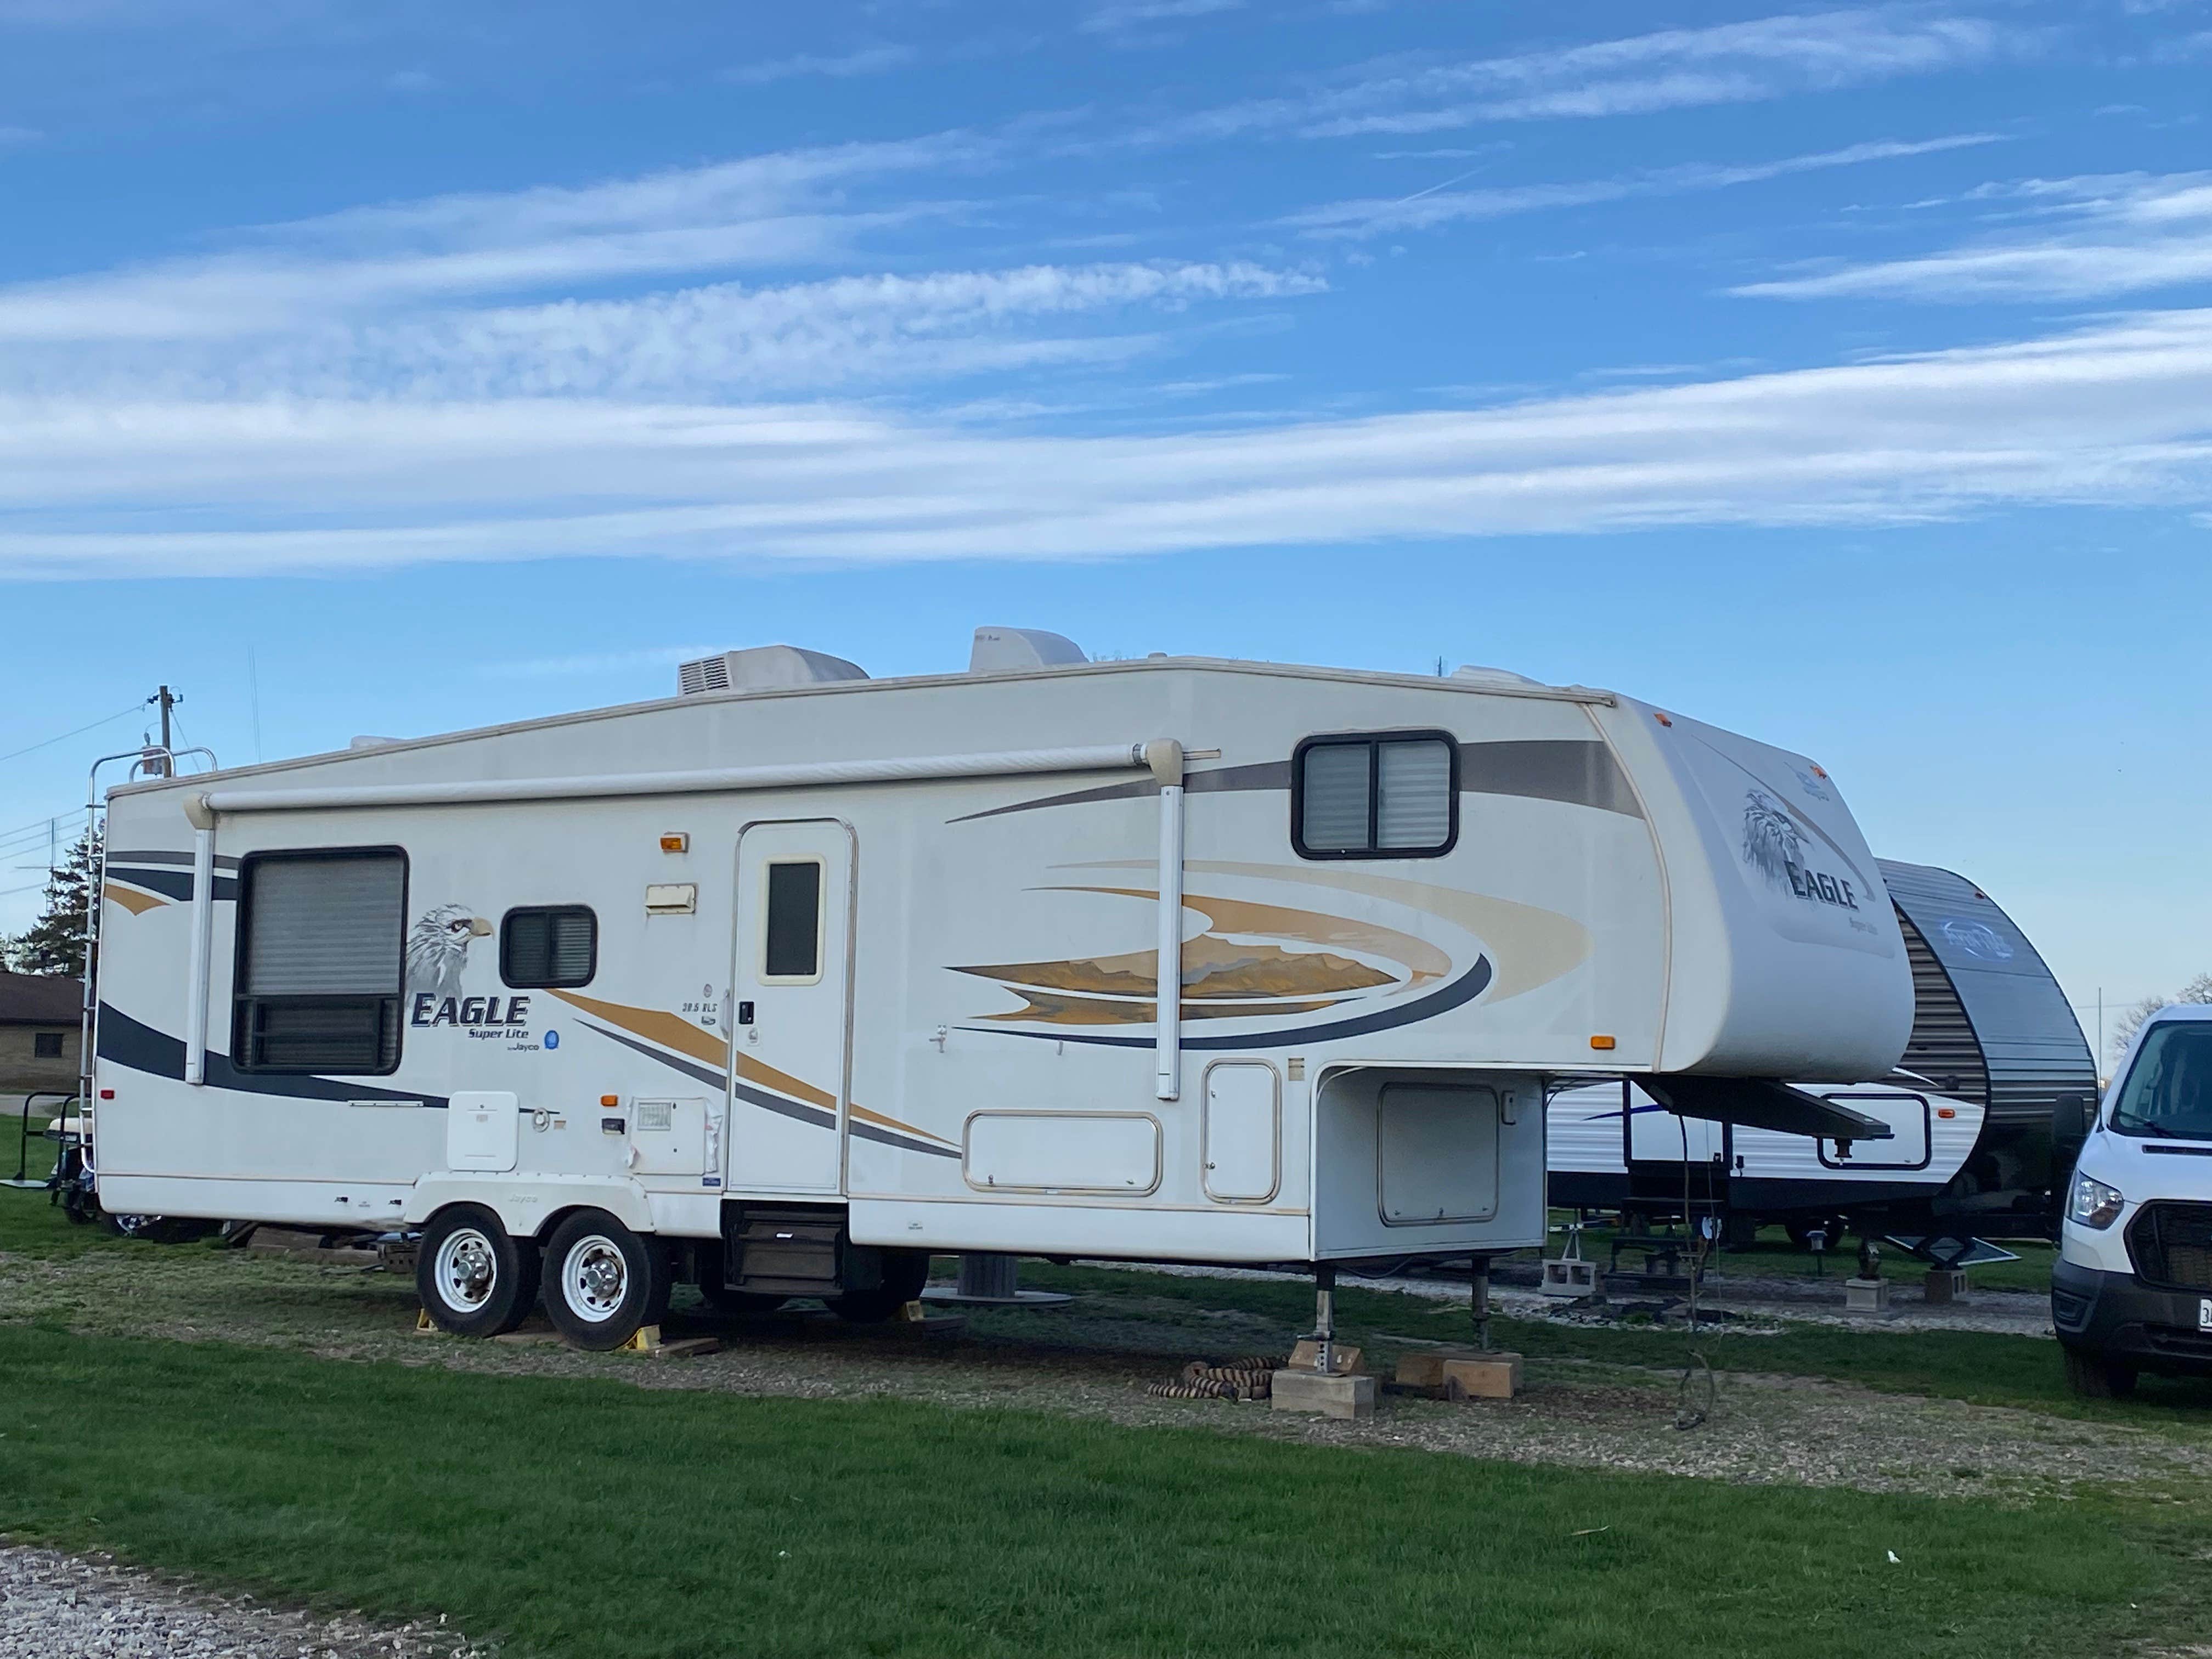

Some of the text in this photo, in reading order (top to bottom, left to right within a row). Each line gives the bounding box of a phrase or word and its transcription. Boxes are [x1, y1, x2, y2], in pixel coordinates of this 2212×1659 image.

[1784, 860, 1860, 912] EAGLE
[411, 993, 531, 1027] EAGLE
[468, 1029, 529, 1040] Super Lite
[515, 1042, 540, 1052] Jayco
